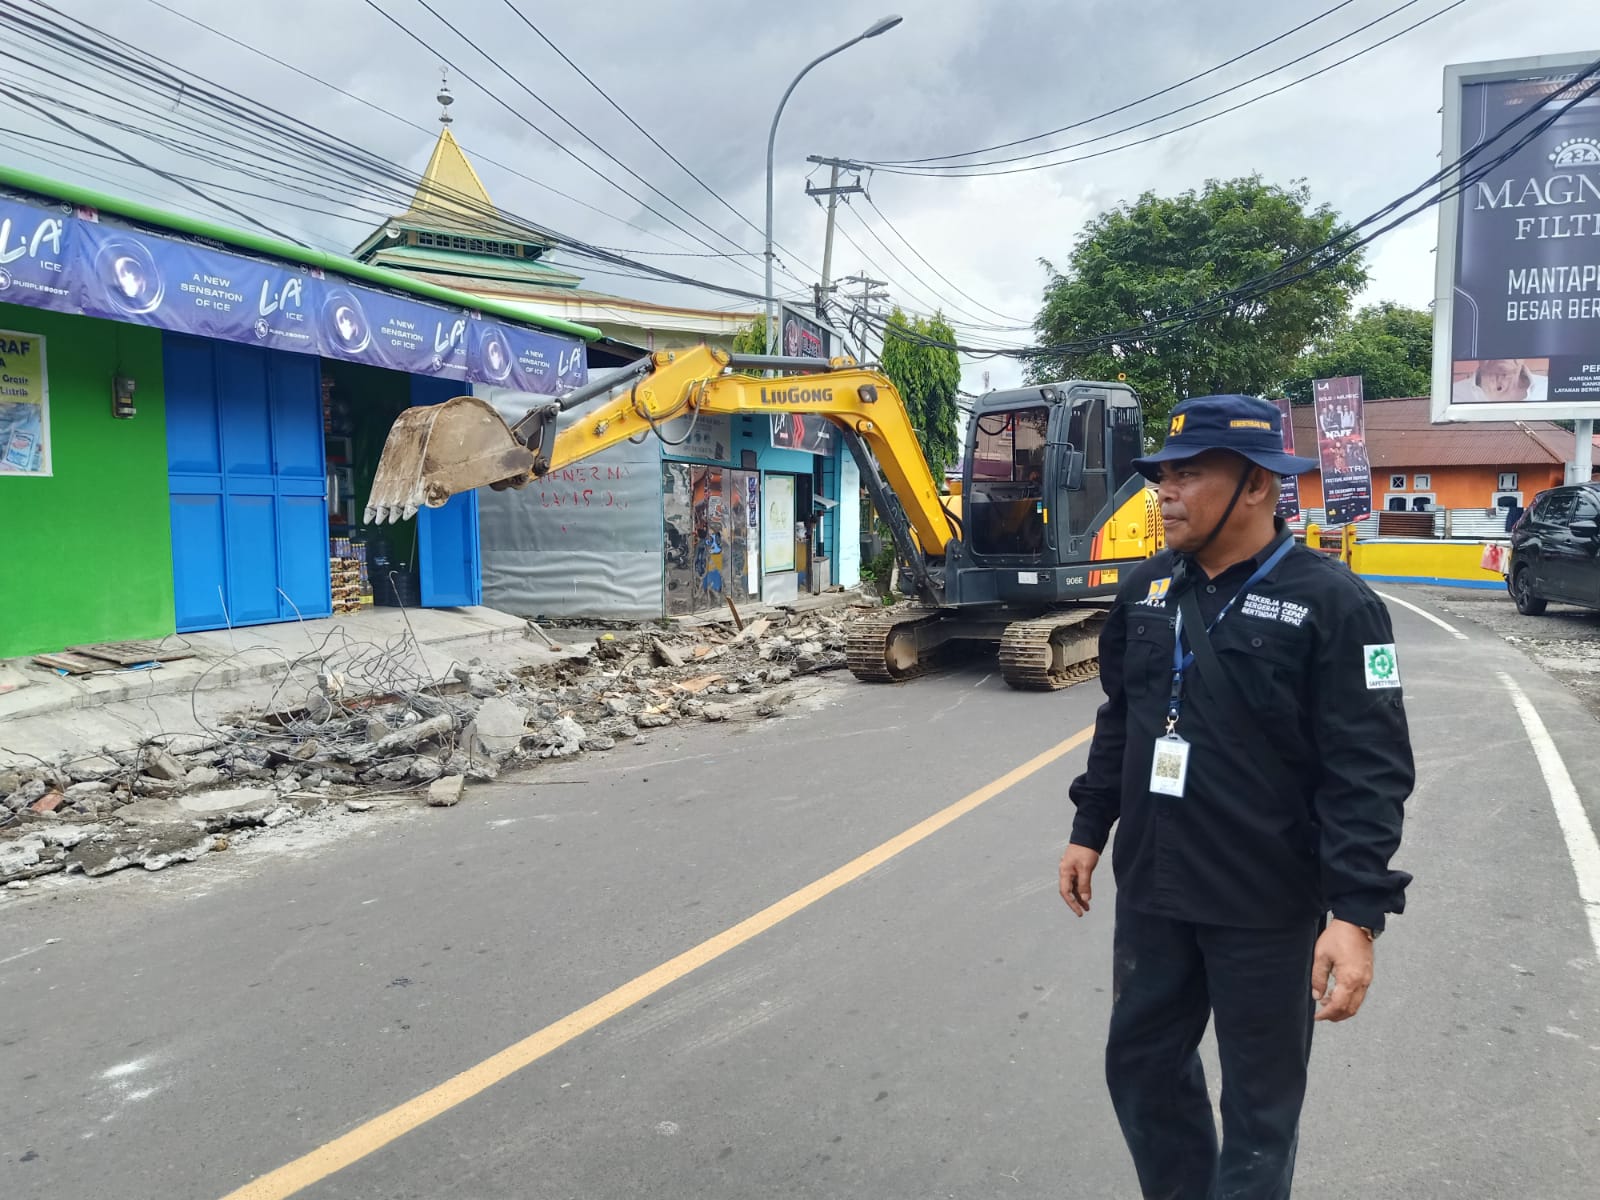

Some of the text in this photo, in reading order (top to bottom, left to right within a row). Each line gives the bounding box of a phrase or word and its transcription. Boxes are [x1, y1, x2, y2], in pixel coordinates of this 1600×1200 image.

[1561, 149, 1597, 164] 234
[40, 260, 62, 272] ICE
[193, 273, 231, 288] A NEW
[1508, 264, 1600, 295] MANTAP
[180, 282, 243, 303] SENSATION
[195, 298, 231, 312] OF ICE
[1507, 299, 1563, 321] BESAR
[286, 312, 304, 321] ICE
[396, 319, 415, 330] NEW
[381, 326, 424, 342] SENSATION
[391, 339, 417, 350] OF ICE
[1065, 576, 1084, 586] 906E
[1243, 600, 1306, 619] BERGERAK CEPAT
[1246, 593, 1309, 614] BEKERJA KERAS
[1280, 614, 1303, 626] TEPAT
